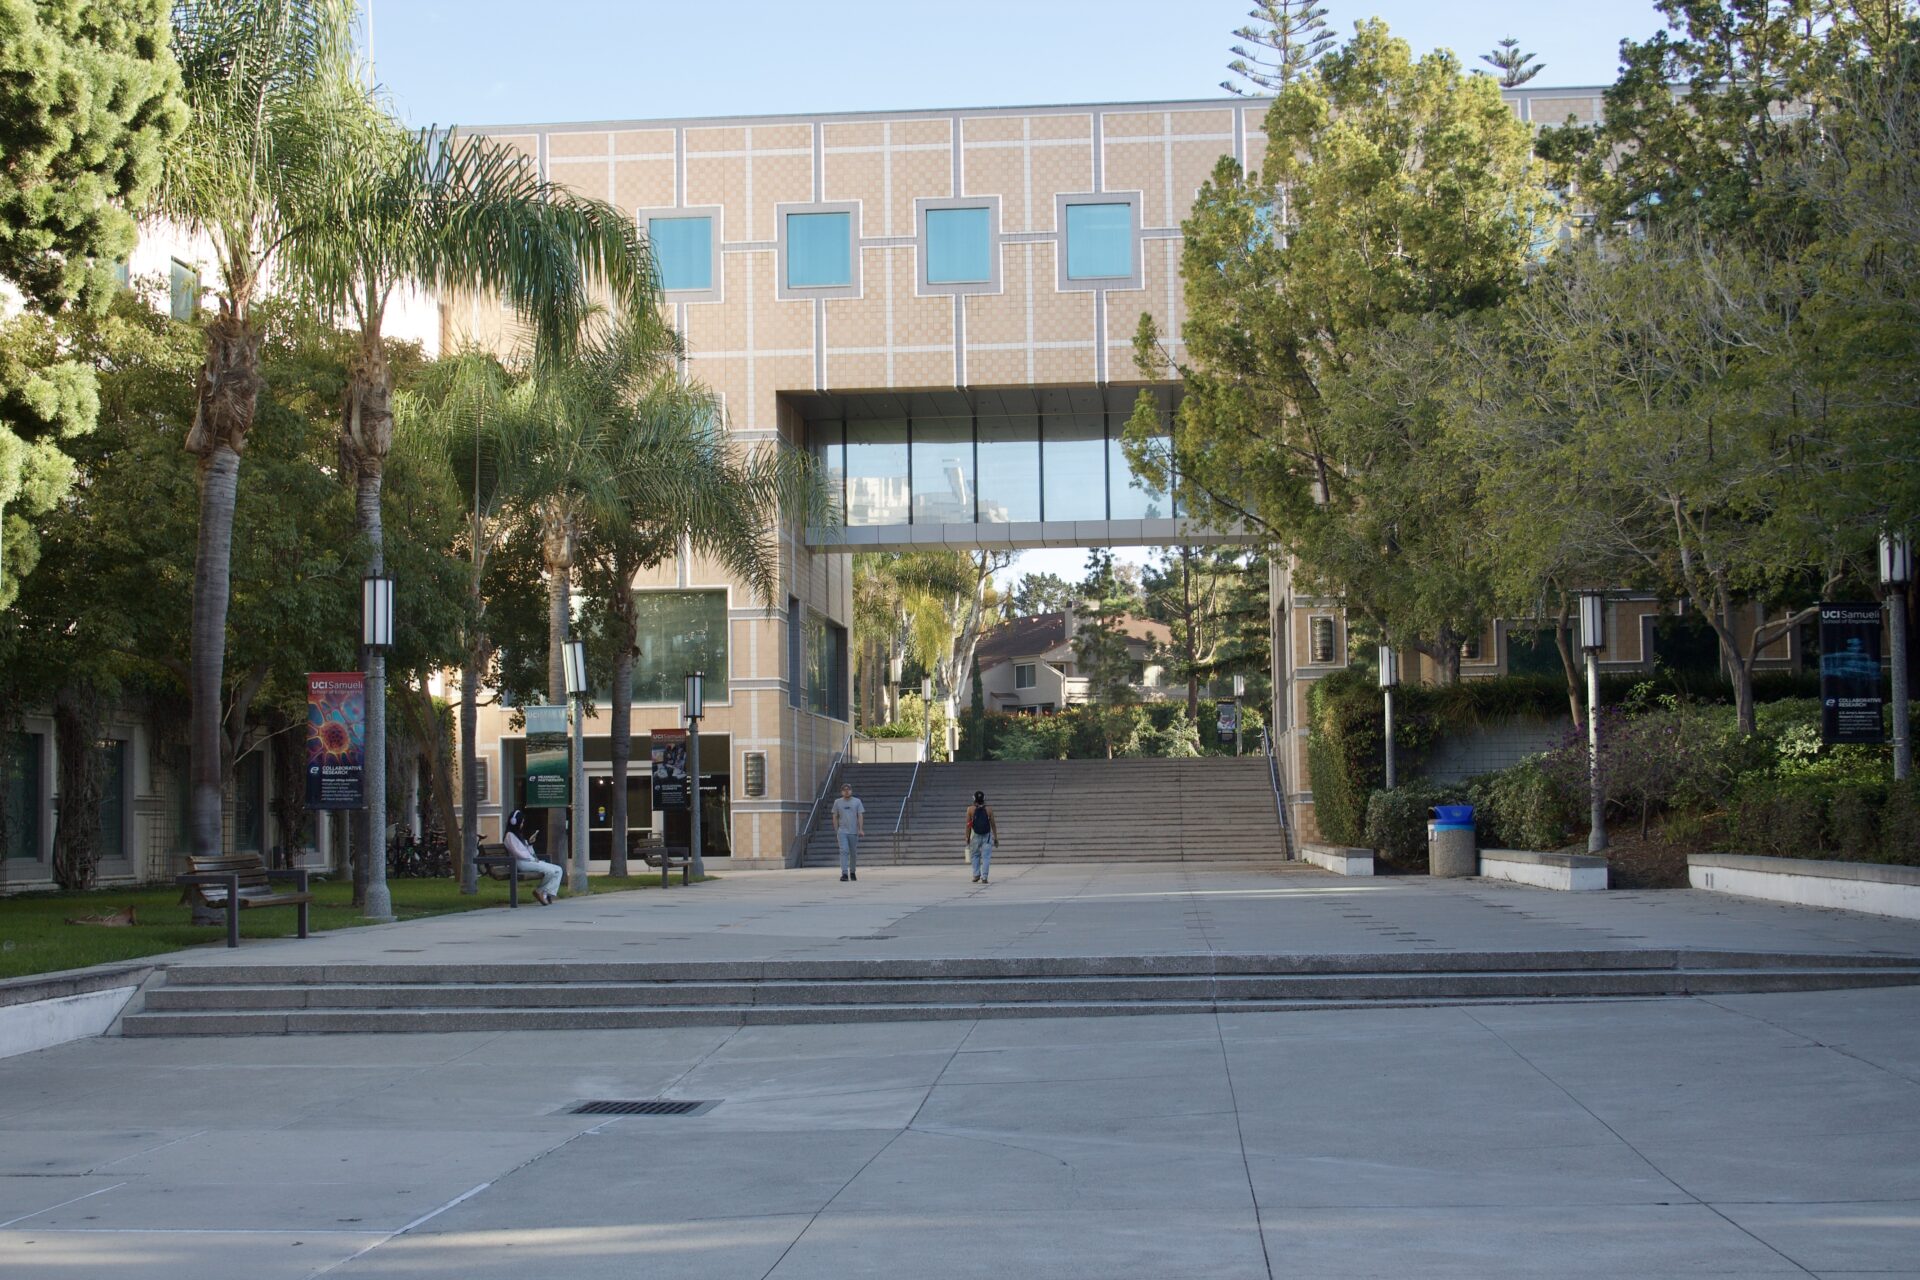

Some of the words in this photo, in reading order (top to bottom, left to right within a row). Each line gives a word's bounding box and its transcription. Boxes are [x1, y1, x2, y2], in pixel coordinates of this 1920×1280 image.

[1822, 610, 1840, 618] UCI
[1841, 610, 1880, 618] Samueli
[328, 680, 362, 688] Samueli
